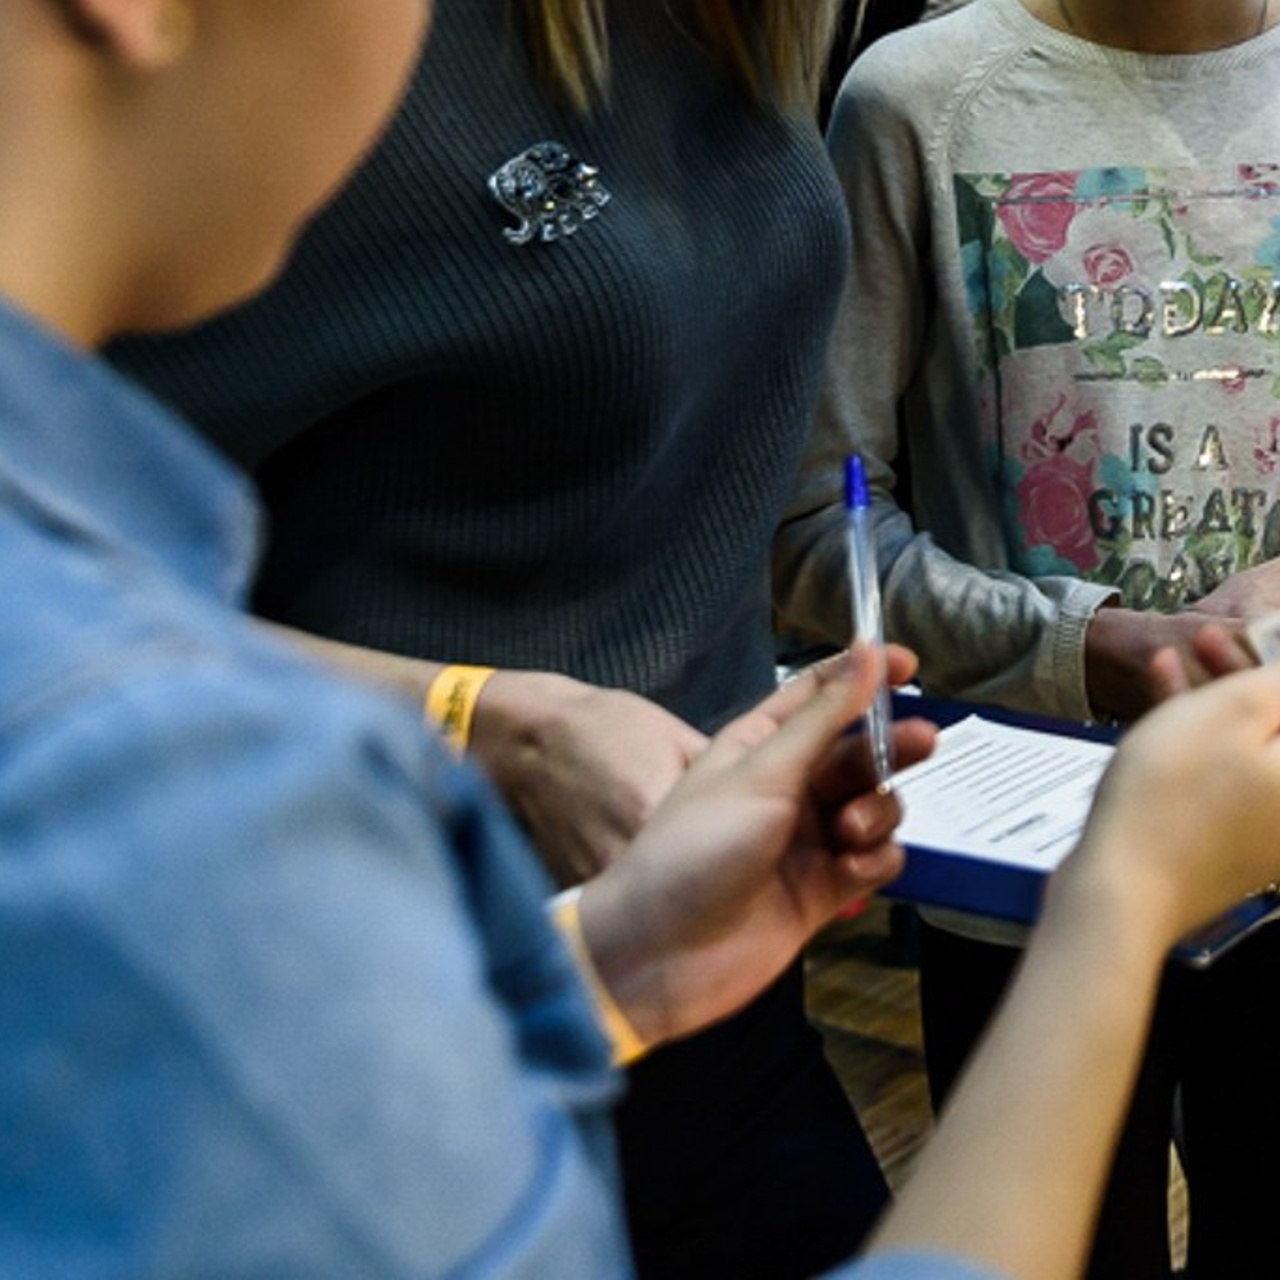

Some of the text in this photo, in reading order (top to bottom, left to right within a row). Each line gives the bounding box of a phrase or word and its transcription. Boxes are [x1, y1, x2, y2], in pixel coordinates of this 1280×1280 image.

[1129, 422, 1229, 475] IS A
[1088, 486, 1266, 540] GREAT
